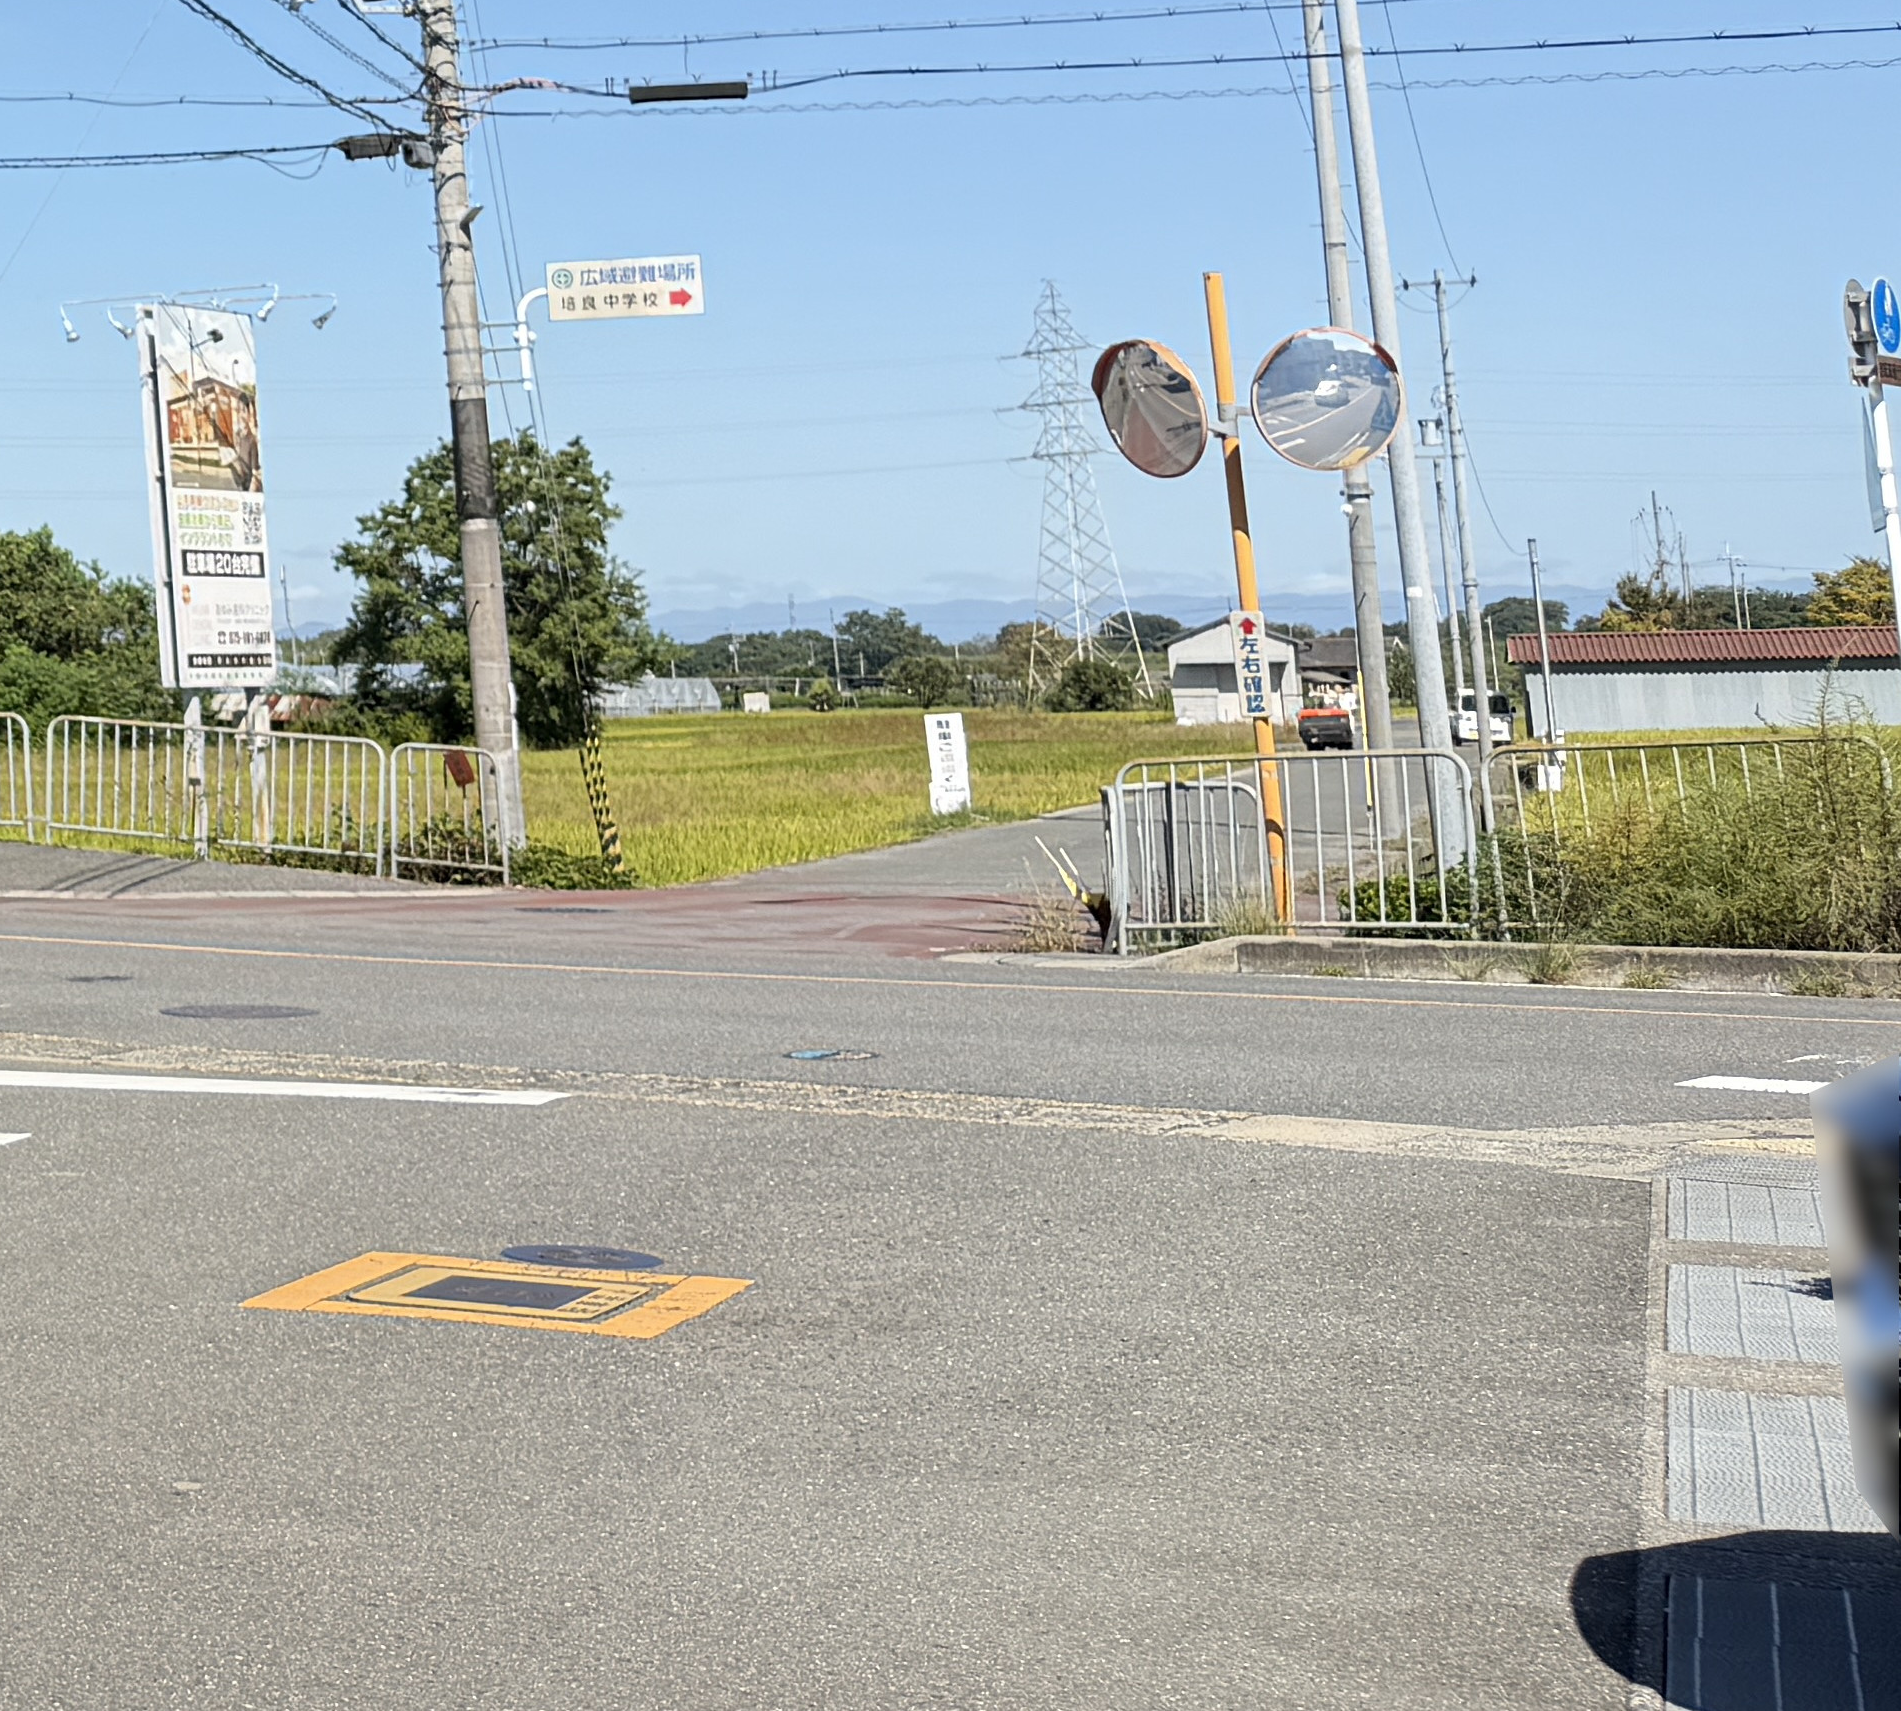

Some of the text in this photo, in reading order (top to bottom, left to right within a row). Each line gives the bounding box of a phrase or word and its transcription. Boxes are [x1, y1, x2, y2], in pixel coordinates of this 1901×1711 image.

[580, 261, 695, 287] 広域避難場所
[1239, 635, 1266, 713] 左右確認
